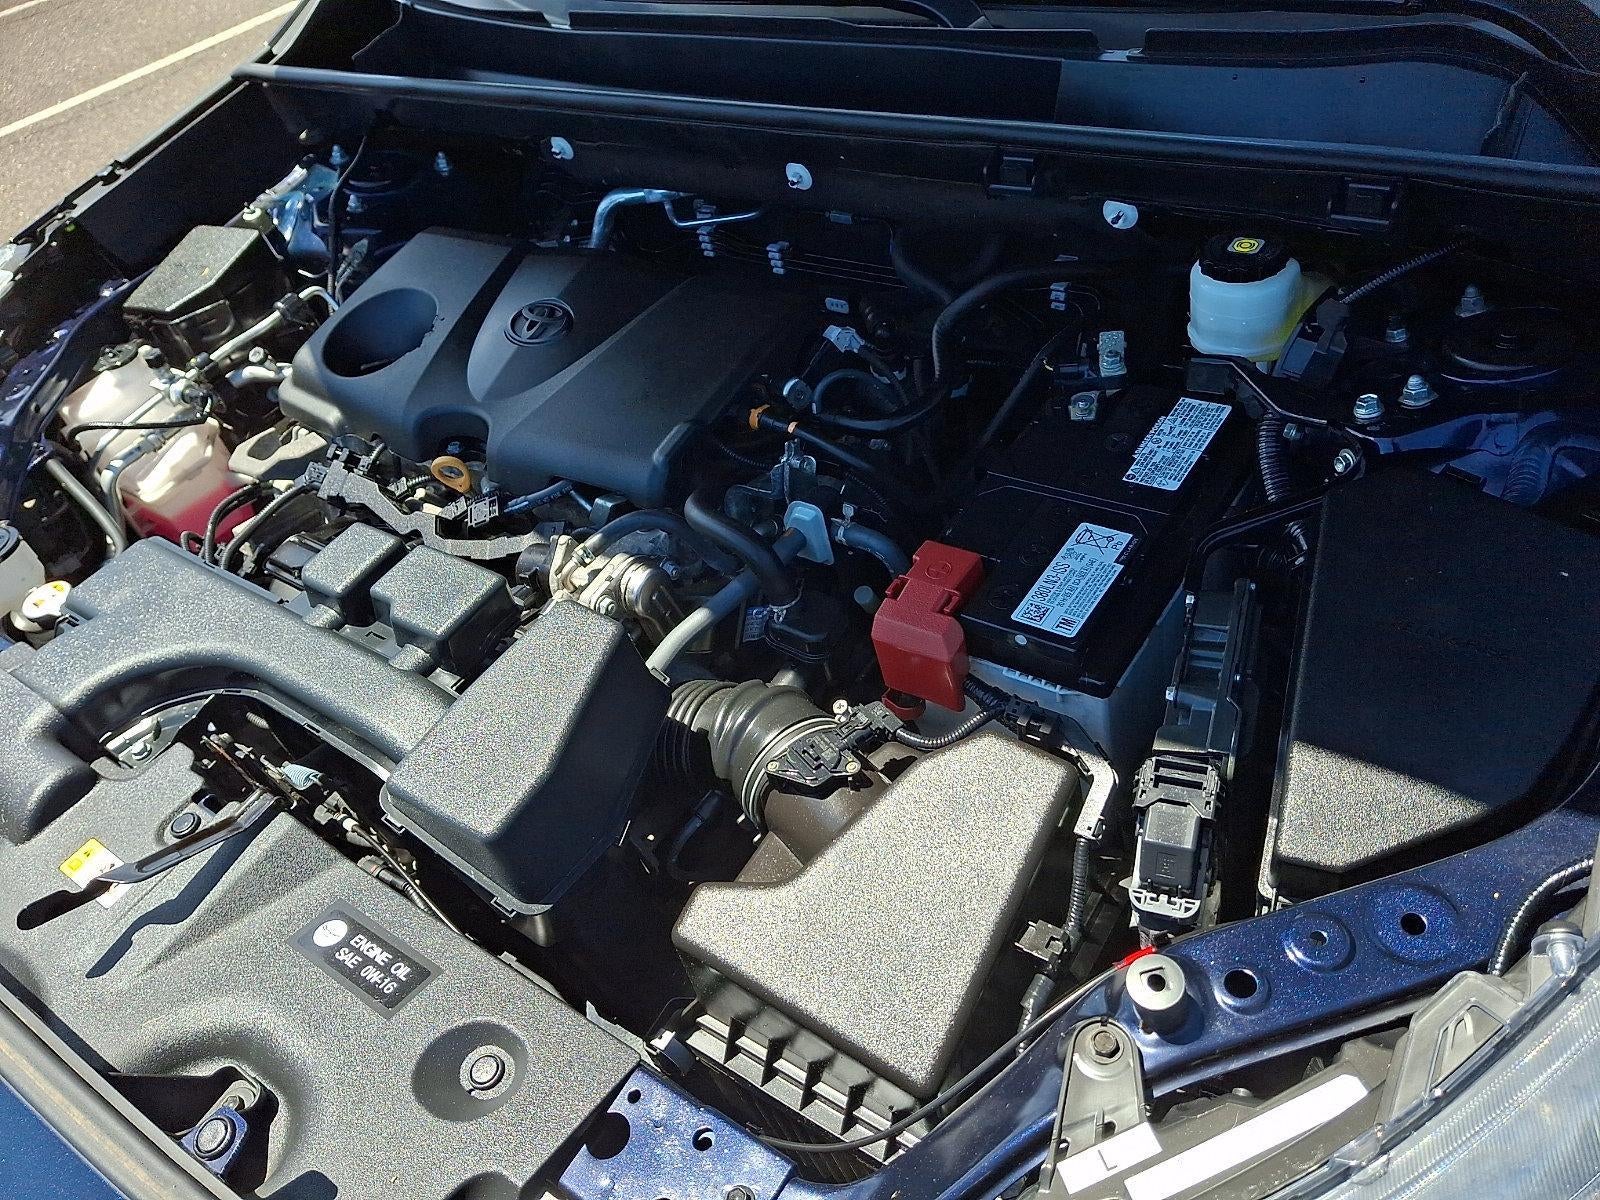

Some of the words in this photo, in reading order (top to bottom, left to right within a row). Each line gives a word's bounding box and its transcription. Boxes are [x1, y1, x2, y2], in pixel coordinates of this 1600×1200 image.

[1110, 540, 1123, 551] Pb
[1055, 617, 1077, 632] TM
[335, 947, 363, 969] SAE
[360, 965, 398, 994] 0W-16
[350, 933, 393, 966] ENGINE
[390, 962, 413, 982] OIL
